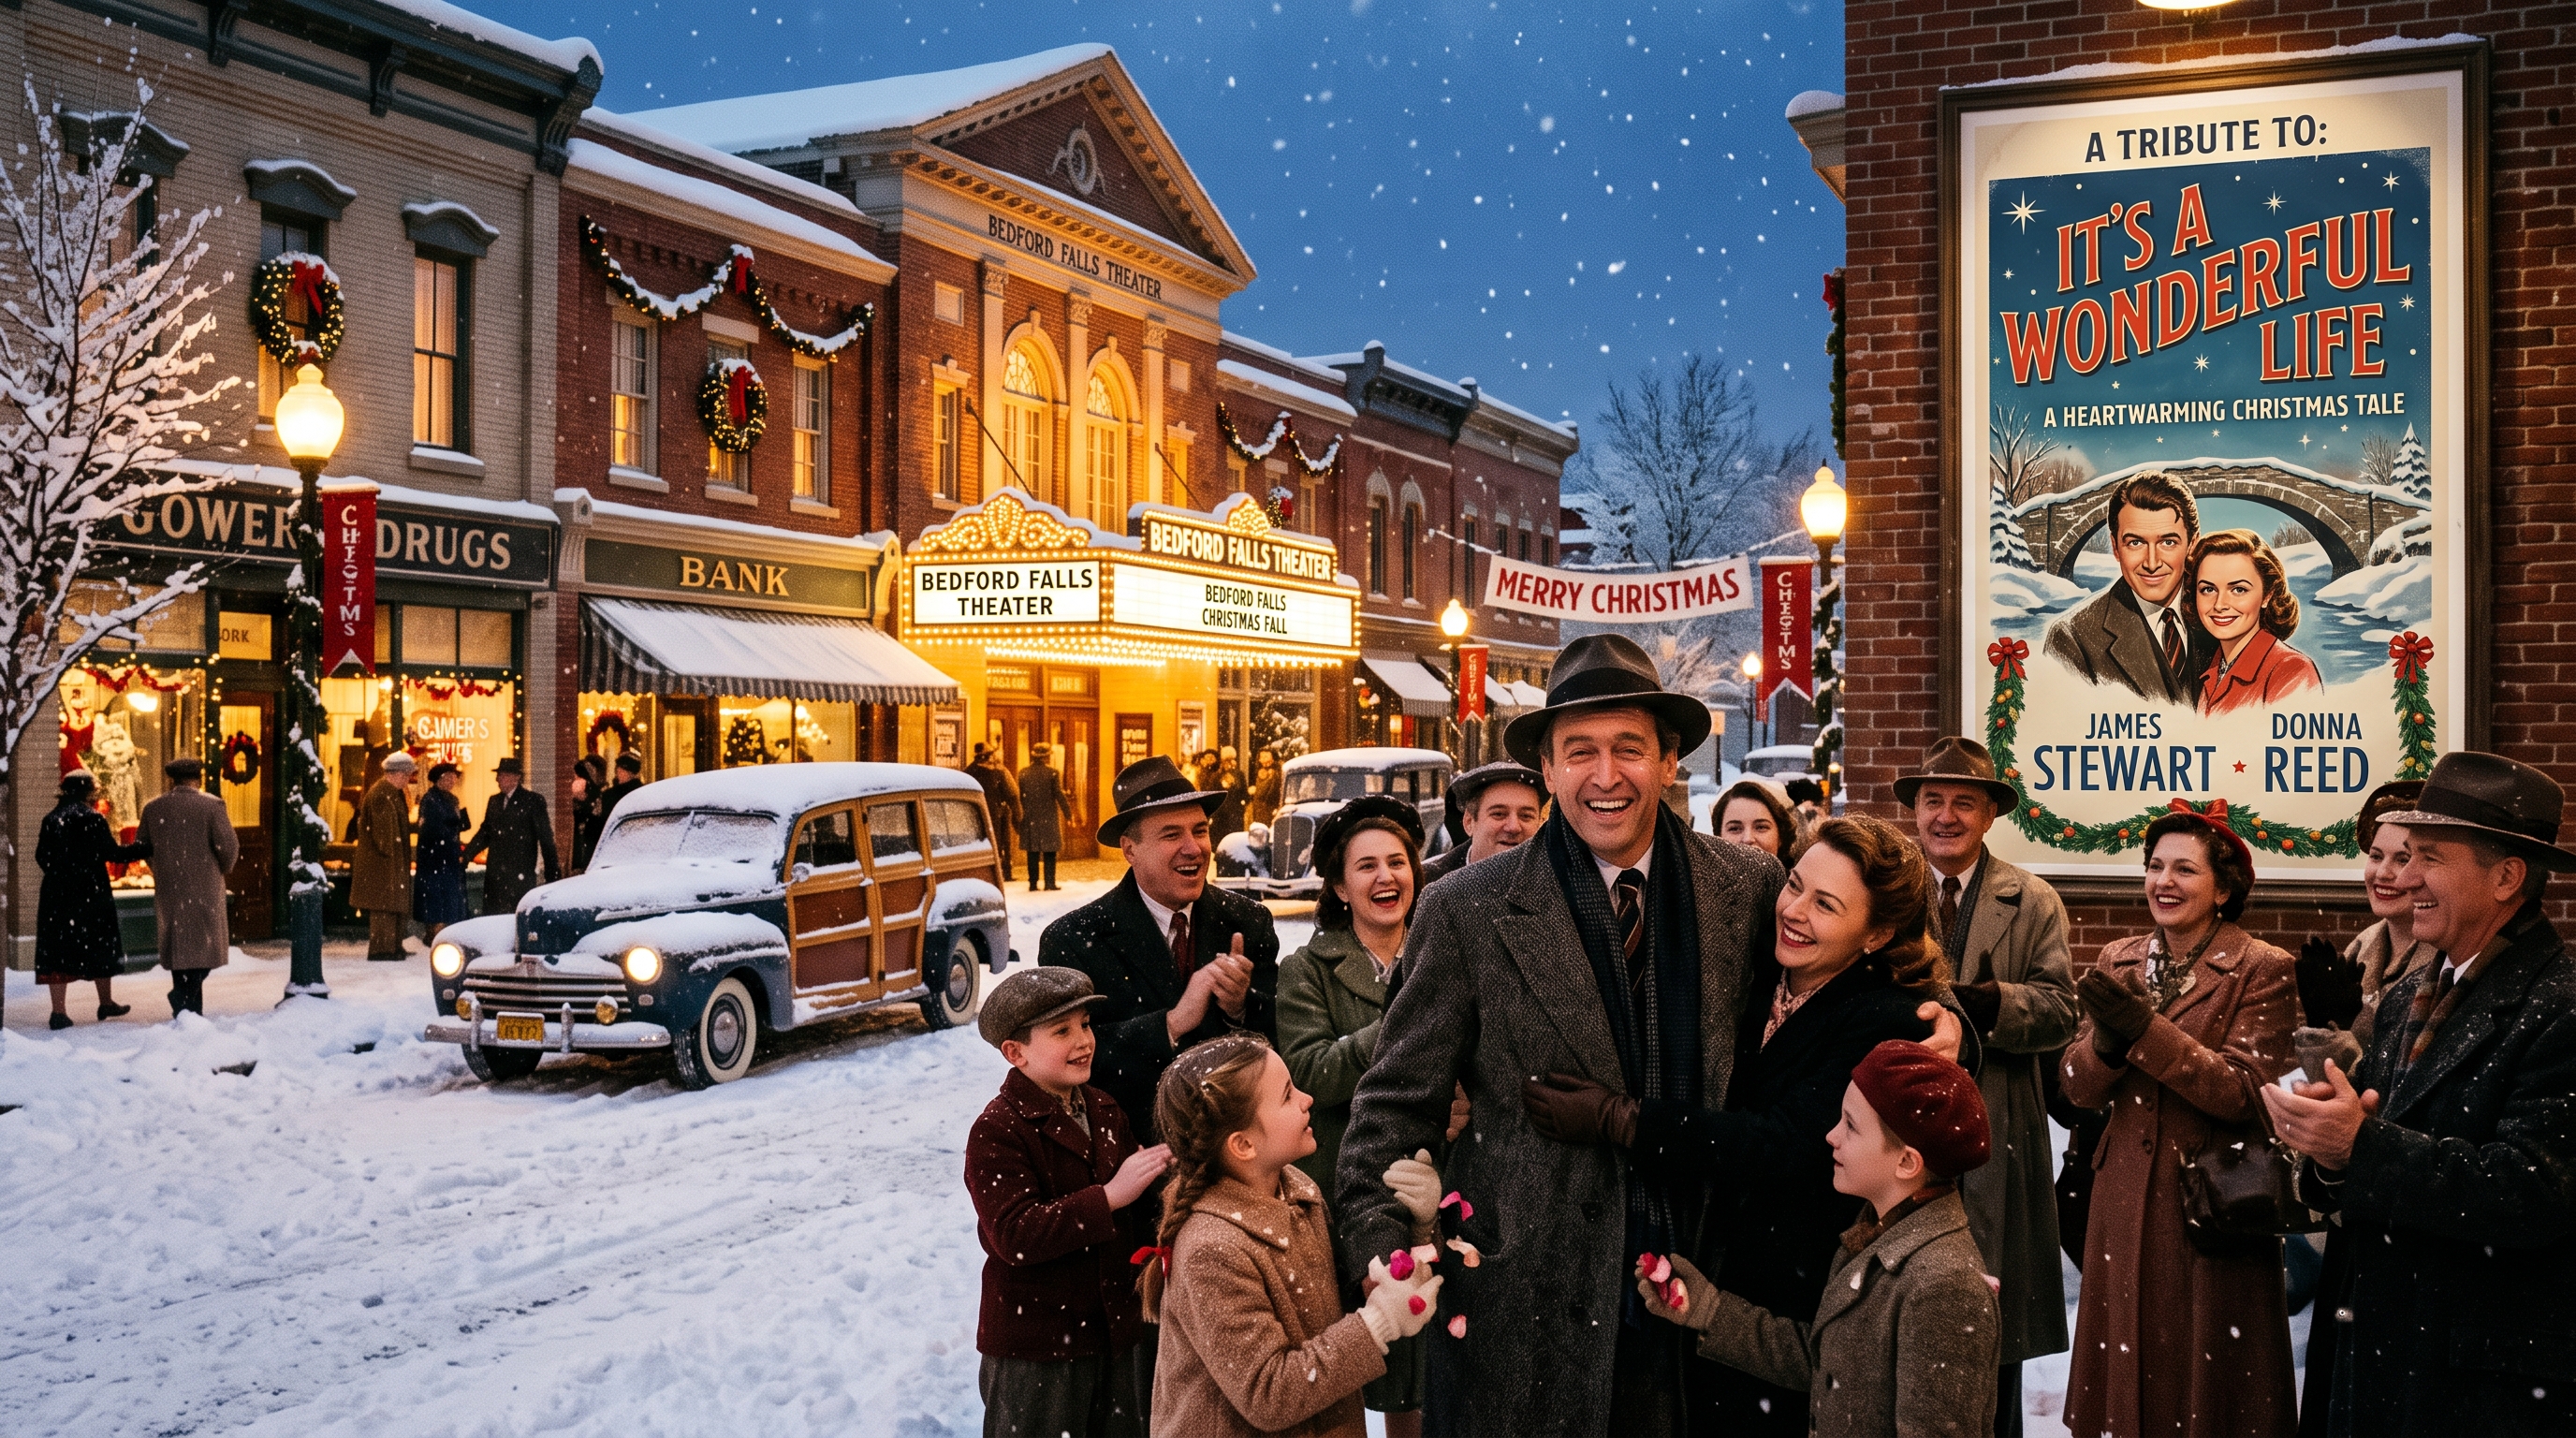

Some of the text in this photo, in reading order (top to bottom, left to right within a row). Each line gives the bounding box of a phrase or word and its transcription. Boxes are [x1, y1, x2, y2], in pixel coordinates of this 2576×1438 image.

[2085, 114, 2328, 163] A TRIBUTE TO:
[988, 213, 1161, 300] BEDFORD FALLS THEATER
[2056, 182, 2215, 294] IT'S A
[1999, 206, 2413, 389] WONDERFUL
[2259, 302, 2387, 385] LIFE
[2043, 392, 2405, 428] A HEARTWARMING CHRISTMAS TALE
[122, 493, 511, 571] GOWER DRUGS
[1150, 521, 1331, 581] BEDFORD FALLS THEATER
[680, 556, 789, 596] BANK
[921, 568, 1093, 592] BEDFORD FALLS
[1206, 583, 1287, 611] BEDFORD FALLS
[1496, 567, 1740, 614] MERRY CHRISTMAS
[957, 596, 1053, 617] THEATER
[1202, 608, 1288, 635] CHRISTMAS FALL
[2085, 712, 2363, 740] JAMES DONNA
[2033, 745, 2369, 793] STEWART REED
